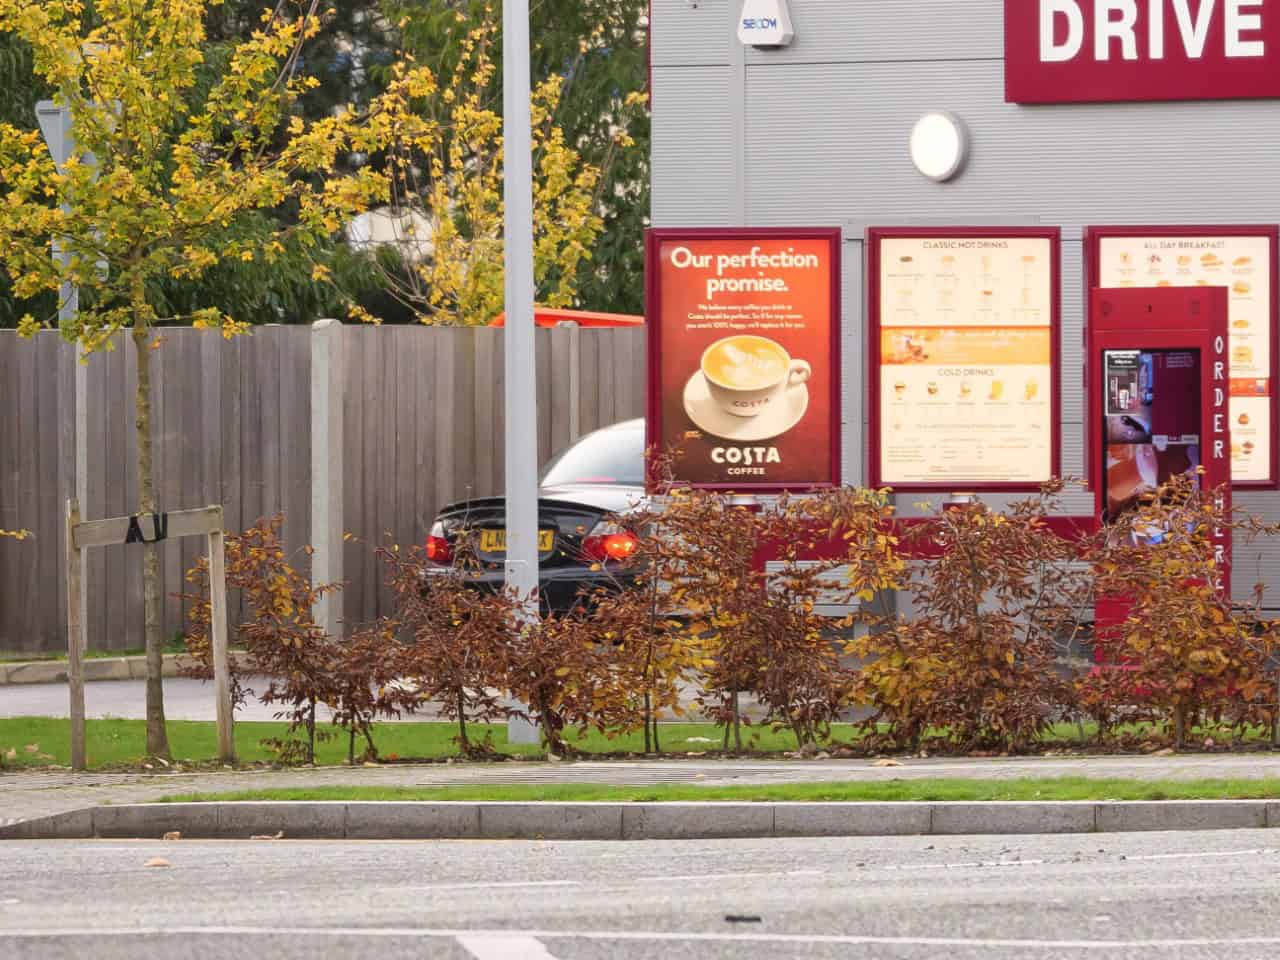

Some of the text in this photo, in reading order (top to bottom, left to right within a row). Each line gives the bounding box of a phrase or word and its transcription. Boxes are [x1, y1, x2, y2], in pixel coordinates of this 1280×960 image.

[743, 18, 777, 30] SECOM
[922, 241, 1008, 249] CLASSIC HOT DRINKS
[671, 247, 819, 276] Our perfection
[707, 272, 789, 301] promise.
[1213, 336, 1224, 459] ORDER
[711, 447, 781, 465] COSTA
[727, 467, 766, 475] COFFEE
